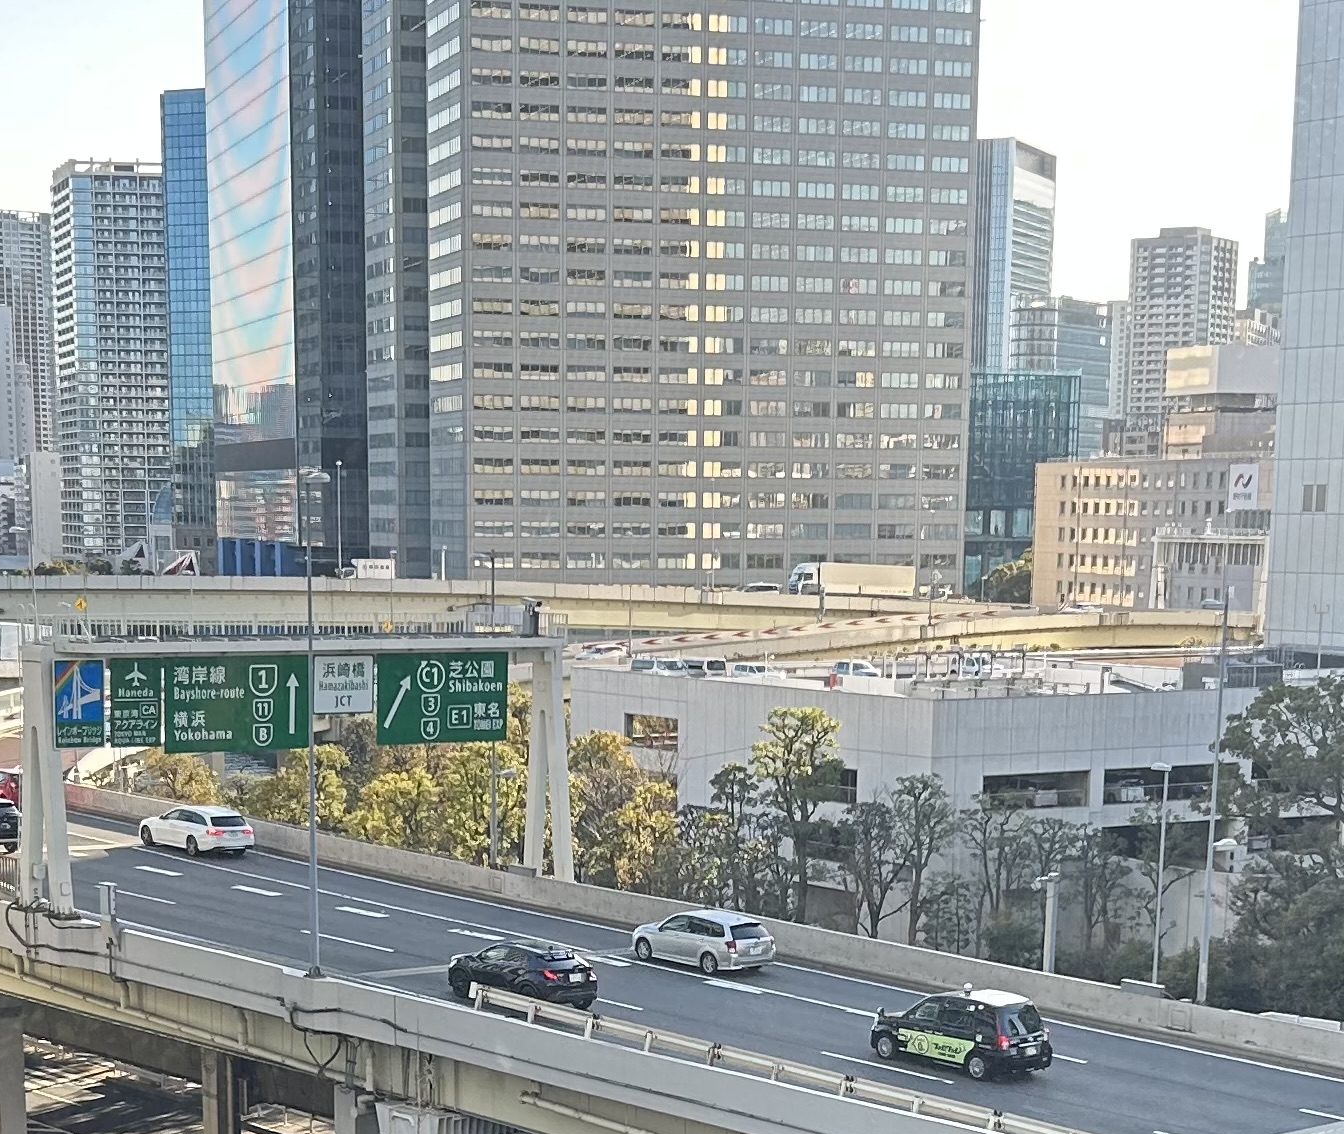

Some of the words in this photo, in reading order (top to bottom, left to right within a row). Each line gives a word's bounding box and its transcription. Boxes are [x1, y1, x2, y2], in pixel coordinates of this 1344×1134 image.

[173, 665, 226, 685] 湾岸線
[422, 666, 438, 686] C1
[449, 660, 495, 678] 芝公園
[258, 670, 269, 689] 1
[448, 679, 503, 693] Shibakoen
[118, 687, 154, 698] Haneda
[173, 686, 245, 702] Bayshore-route
[334, 695, 353, 708] JCT
[427, 697, 435, 711] 3
[142, 705, 157, 715] CA
[257, 702, 268, 716] 11
[473, 702, 500, 718] 東名
[173, 710, 206, 728] 横浜
[451, 709, 467, 724] E1
[114, 719, 158, 730] アクアライン
[426, 721, 434, 735] 4
[174, 728, 233, 741] Yokohama
[259, 727, 268, 741] B
